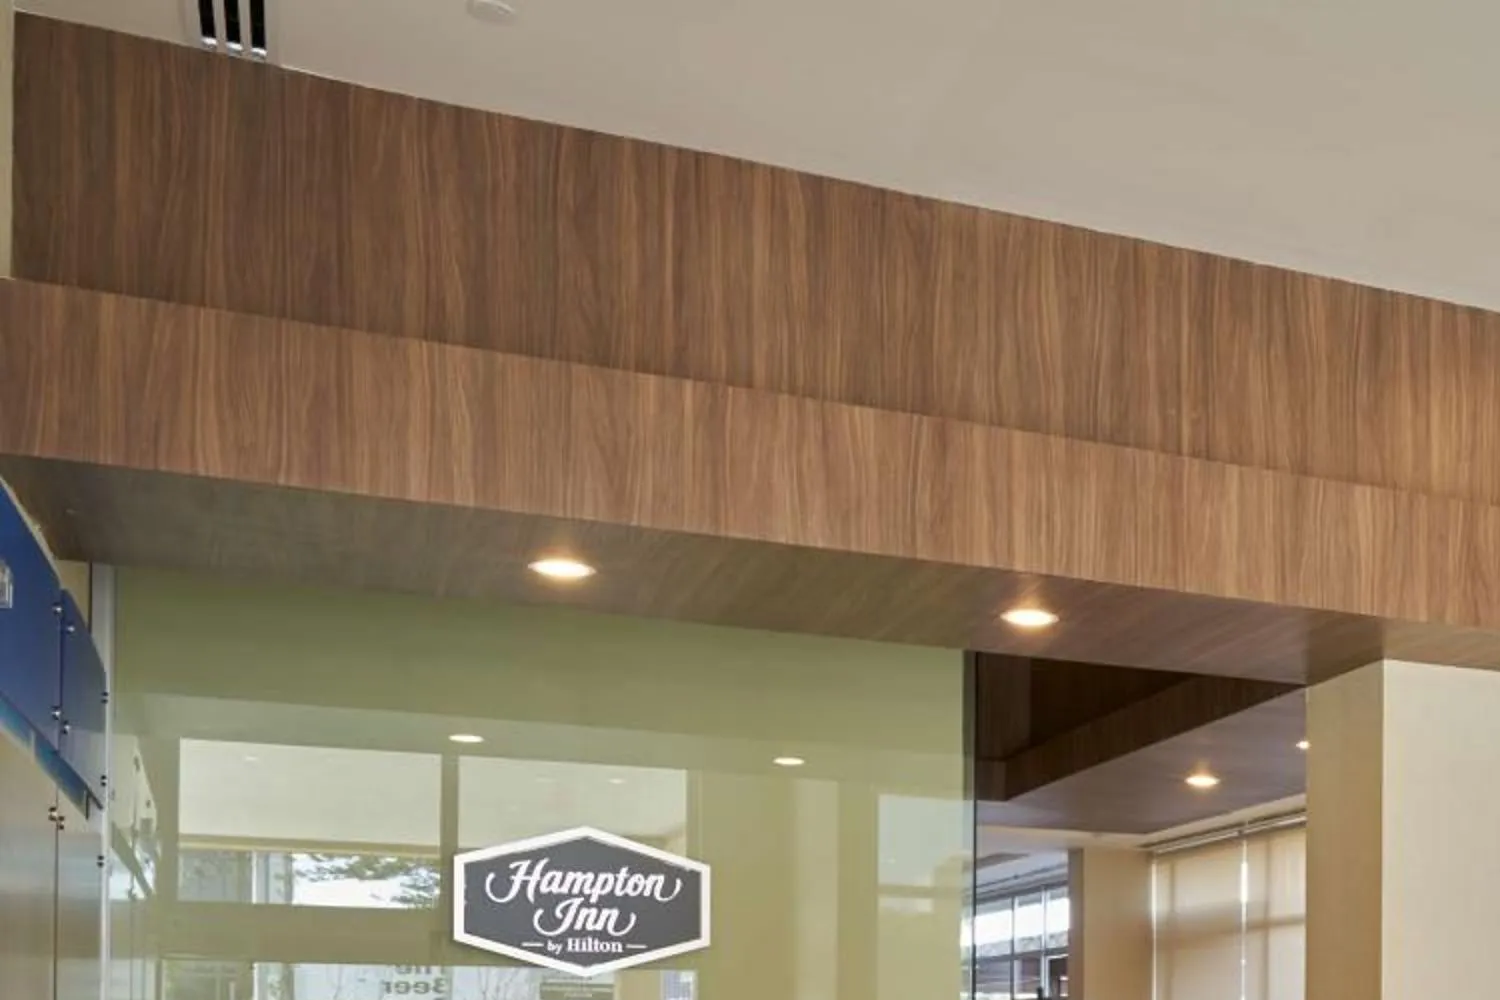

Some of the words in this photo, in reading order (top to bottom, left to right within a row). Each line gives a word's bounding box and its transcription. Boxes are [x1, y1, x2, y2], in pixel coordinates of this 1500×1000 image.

[485, 857, 683, 904] Hampton
[533, 897, 637, 937] Inn
[547, 940, 563, 955] by
[567, 938, 623, 953] Hilton
